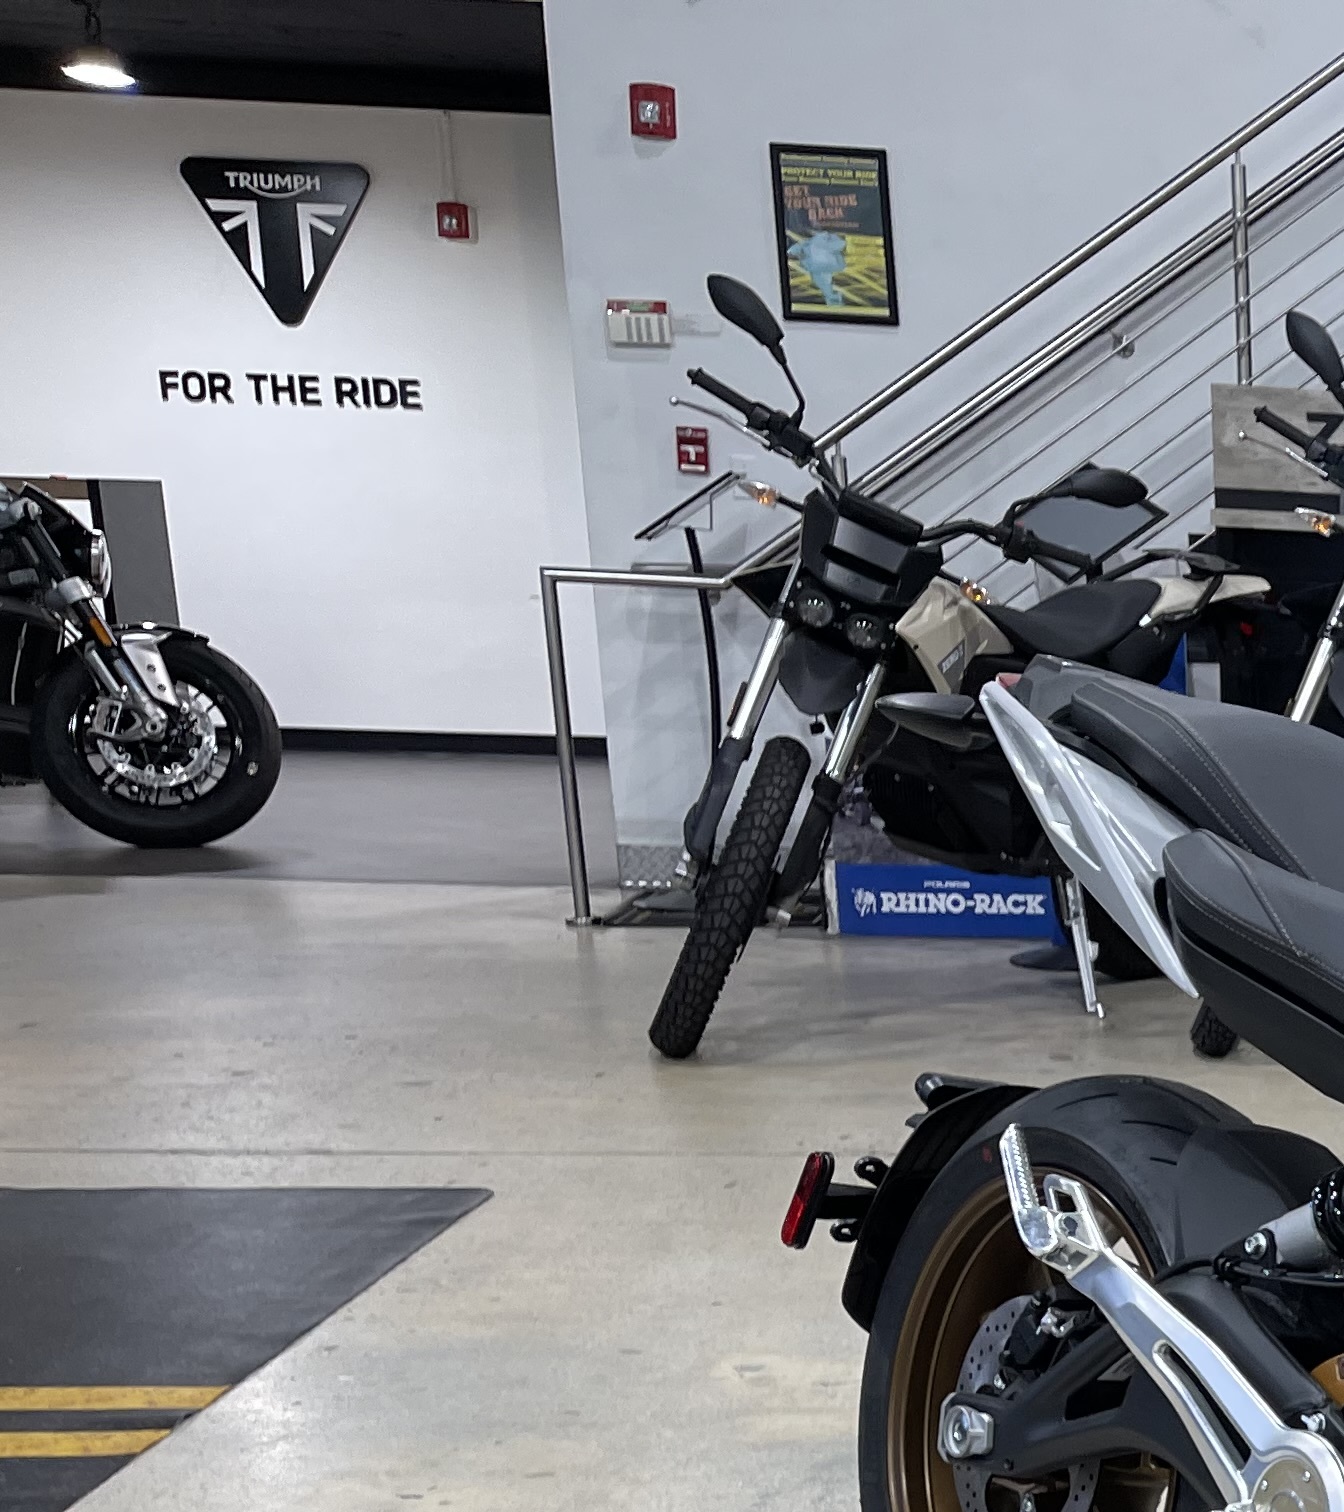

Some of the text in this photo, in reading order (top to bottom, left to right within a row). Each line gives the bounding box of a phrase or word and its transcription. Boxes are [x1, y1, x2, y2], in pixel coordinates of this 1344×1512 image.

[224, 171, 322, 194] TRIUMPH
[158, 369, 424, 411] FOR THE RIDE
[923, 880, 971, 889] POLARIS
[879, 891, 1046, 916] RHINO-RACK
